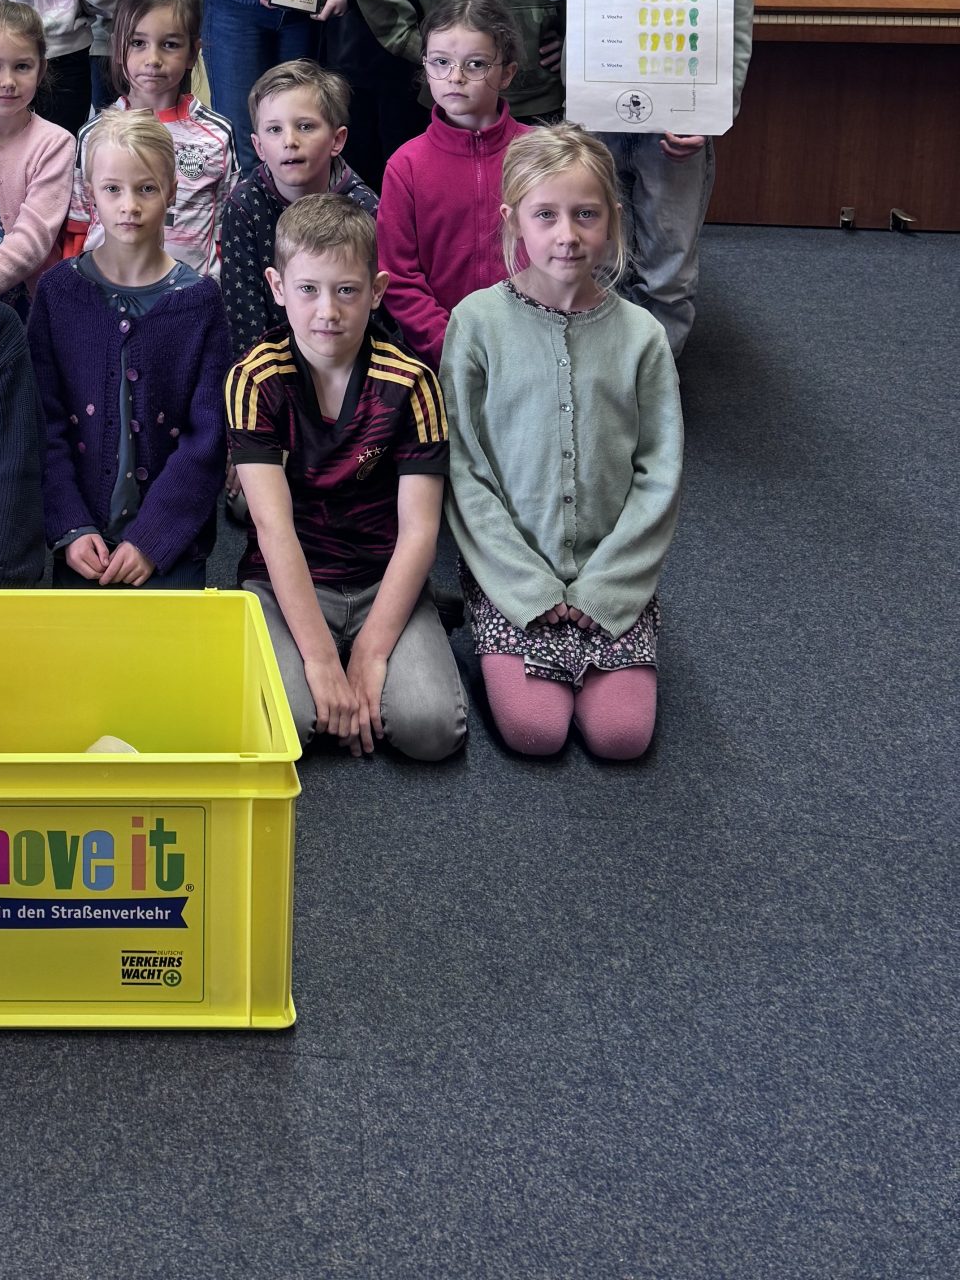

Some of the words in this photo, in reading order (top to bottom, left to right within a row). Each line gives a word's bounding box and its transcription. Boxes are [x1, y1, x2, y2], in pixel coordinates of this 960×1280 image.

[17, 905, 46, 919] den
[51, 904, 172, 920] Straßenverkehr
[121, 956, 183, 968] VERKEHRS
[121, 968, 164, 980] WACHT
